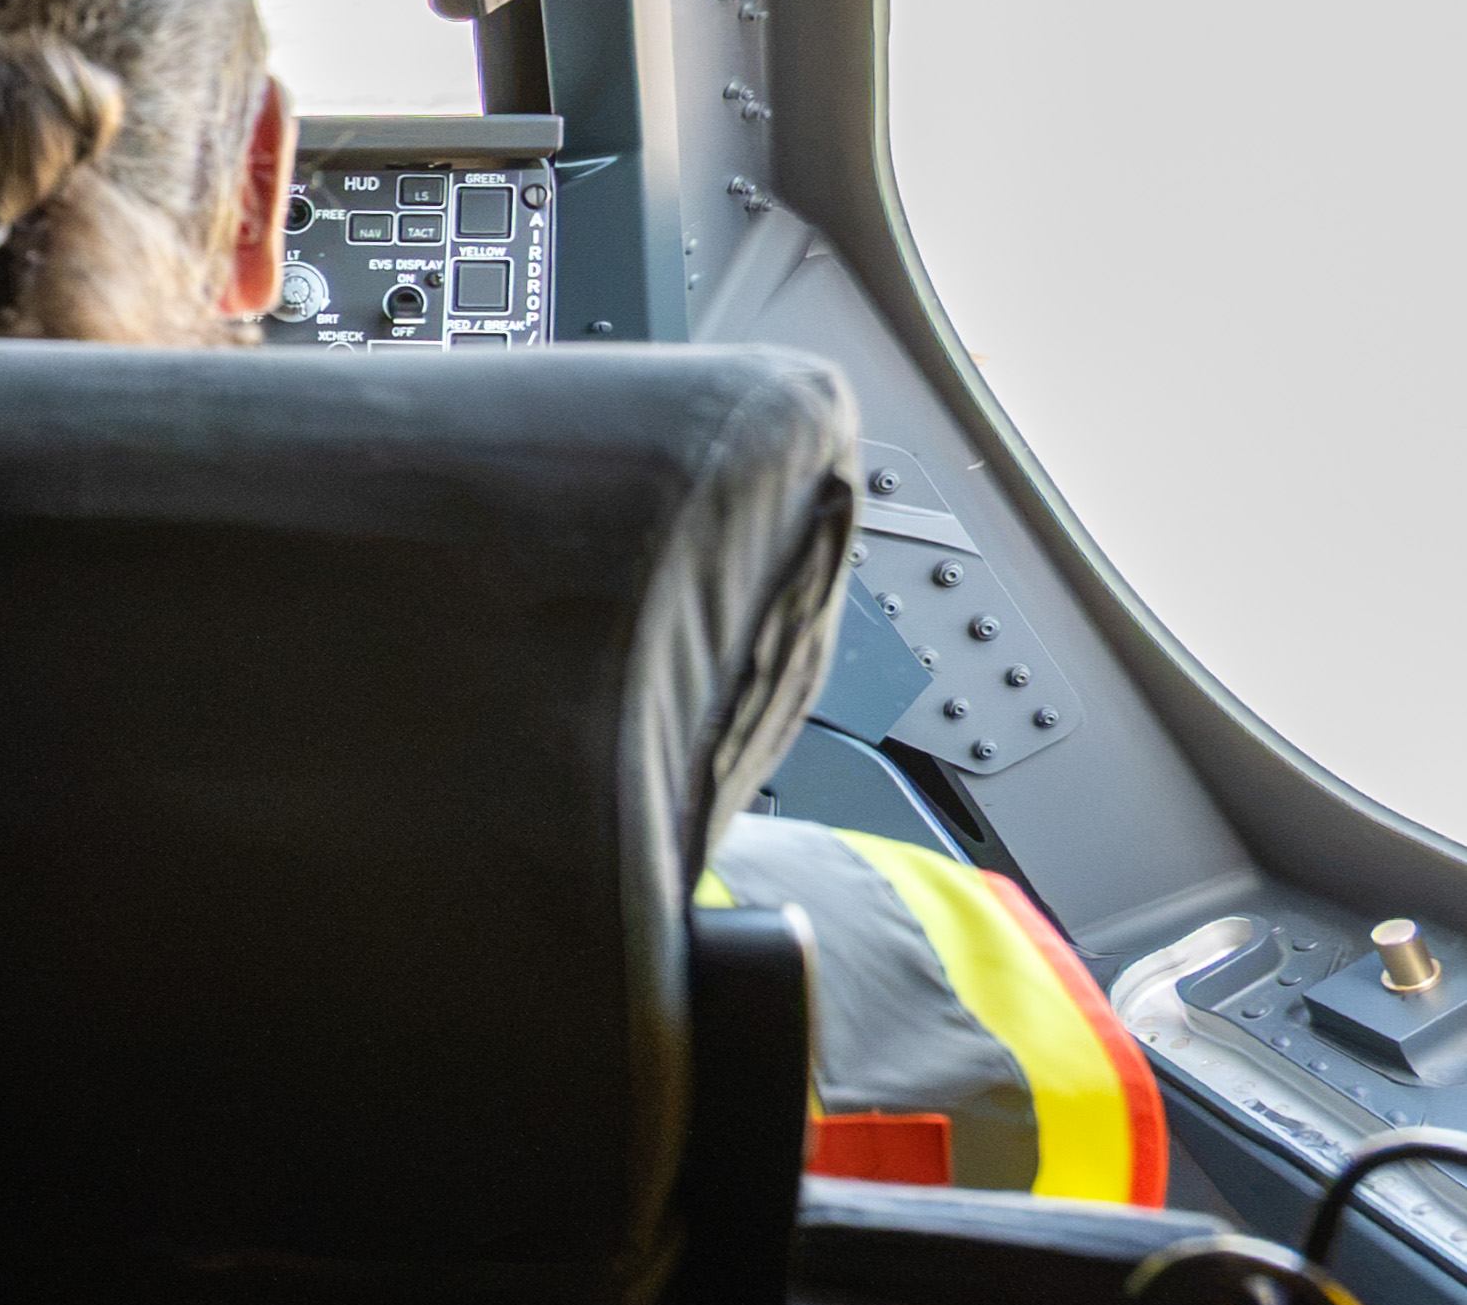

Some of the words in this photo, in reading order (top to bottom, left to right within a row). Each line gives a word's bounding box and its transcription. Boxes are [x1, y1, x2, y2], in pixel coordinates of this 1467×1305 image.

[344, 176, 380, 191] HUD
[465, 174, 505, 184] GREEN
[316, 210, 346, 220] FREE
[360, 229, 382, 238] NAV
[408, 228, 435, 238] TACT
[459, 247, 506, 257] YELLOW
[369, 260, 392, 270] EVS
[396, 260, 443, 273] DISPLAY
[318, 332, 364, 342] XCHECK
